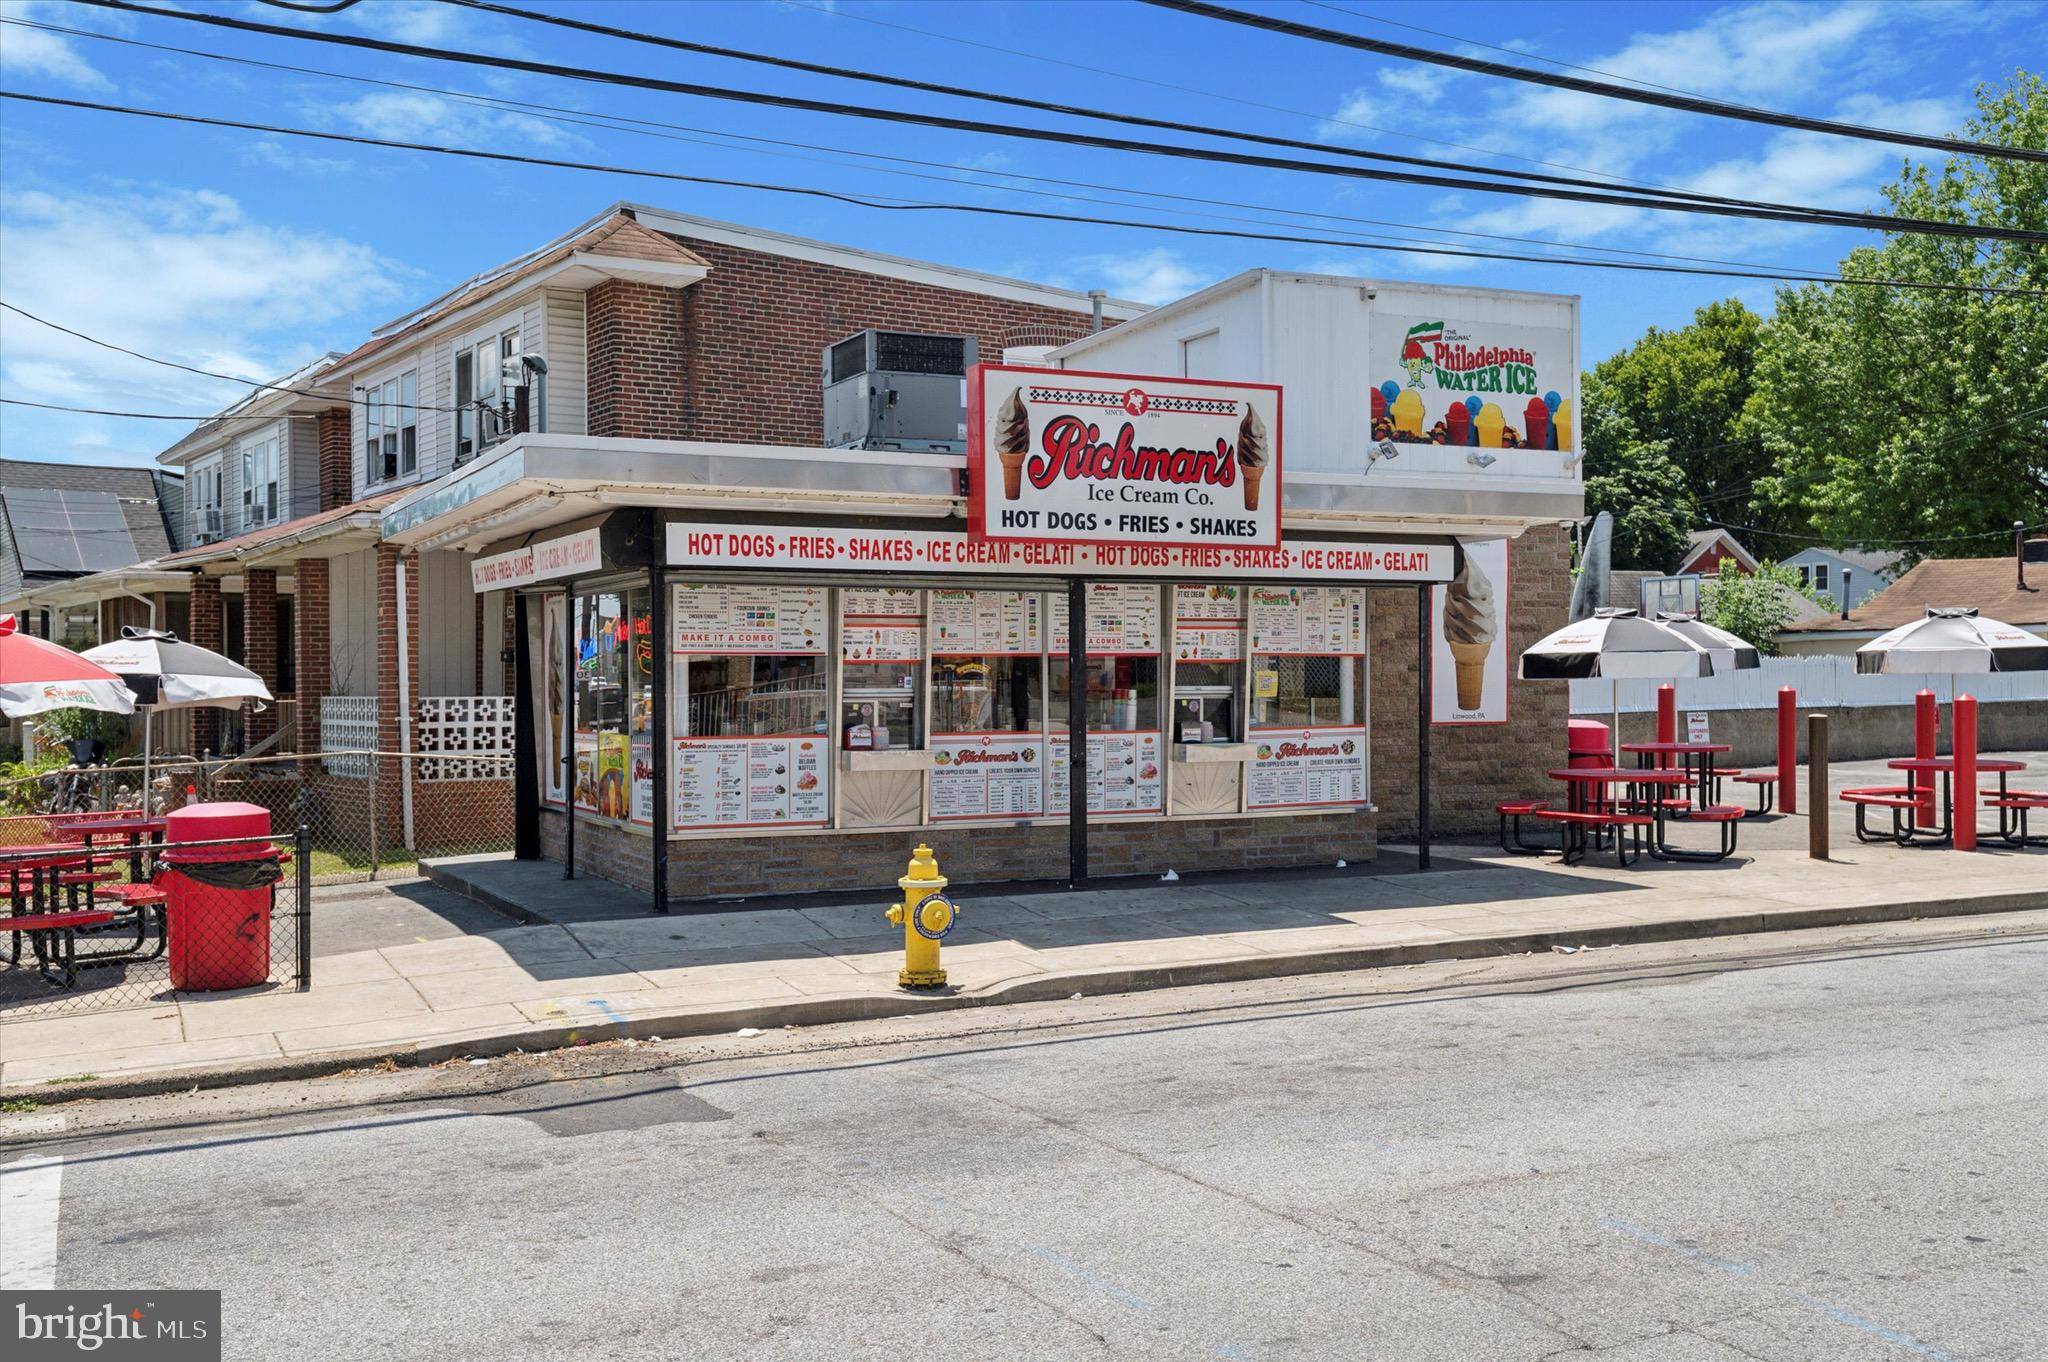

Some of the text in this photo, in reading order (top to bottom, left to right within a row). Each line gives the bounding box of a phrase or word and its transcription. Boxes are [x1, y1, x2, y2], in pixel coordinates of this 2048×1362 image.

[1433, 341, 1533, 372] Philadelphia
[1435, 362, 1538, 395] WATER ICE
[1104, 408, 1161, 419] SINCE 1894
[1027, 414, 1236, 490] Richman's
[1087, 483, 1214, 506] Ice Cream Co.
[1001, 509, 1257, 537] HOT DOGS FRIES SHAKES
[688, 533, 1429, 572] HOT DOGS FRIES SHAKES ICE CREAM GELATI HOT DOGS FRIES SHAKES ICE CREAM GELATI
[1191, 590, 1205, 598] CREAM
[681, 634, 774, 642] MAKE IT A COMBO
[1452, 712, 1486, 721] Linwood, PA
[954, 749, 1019, 766] Richman's
[1275, 742, 1340, 760] Richman's
